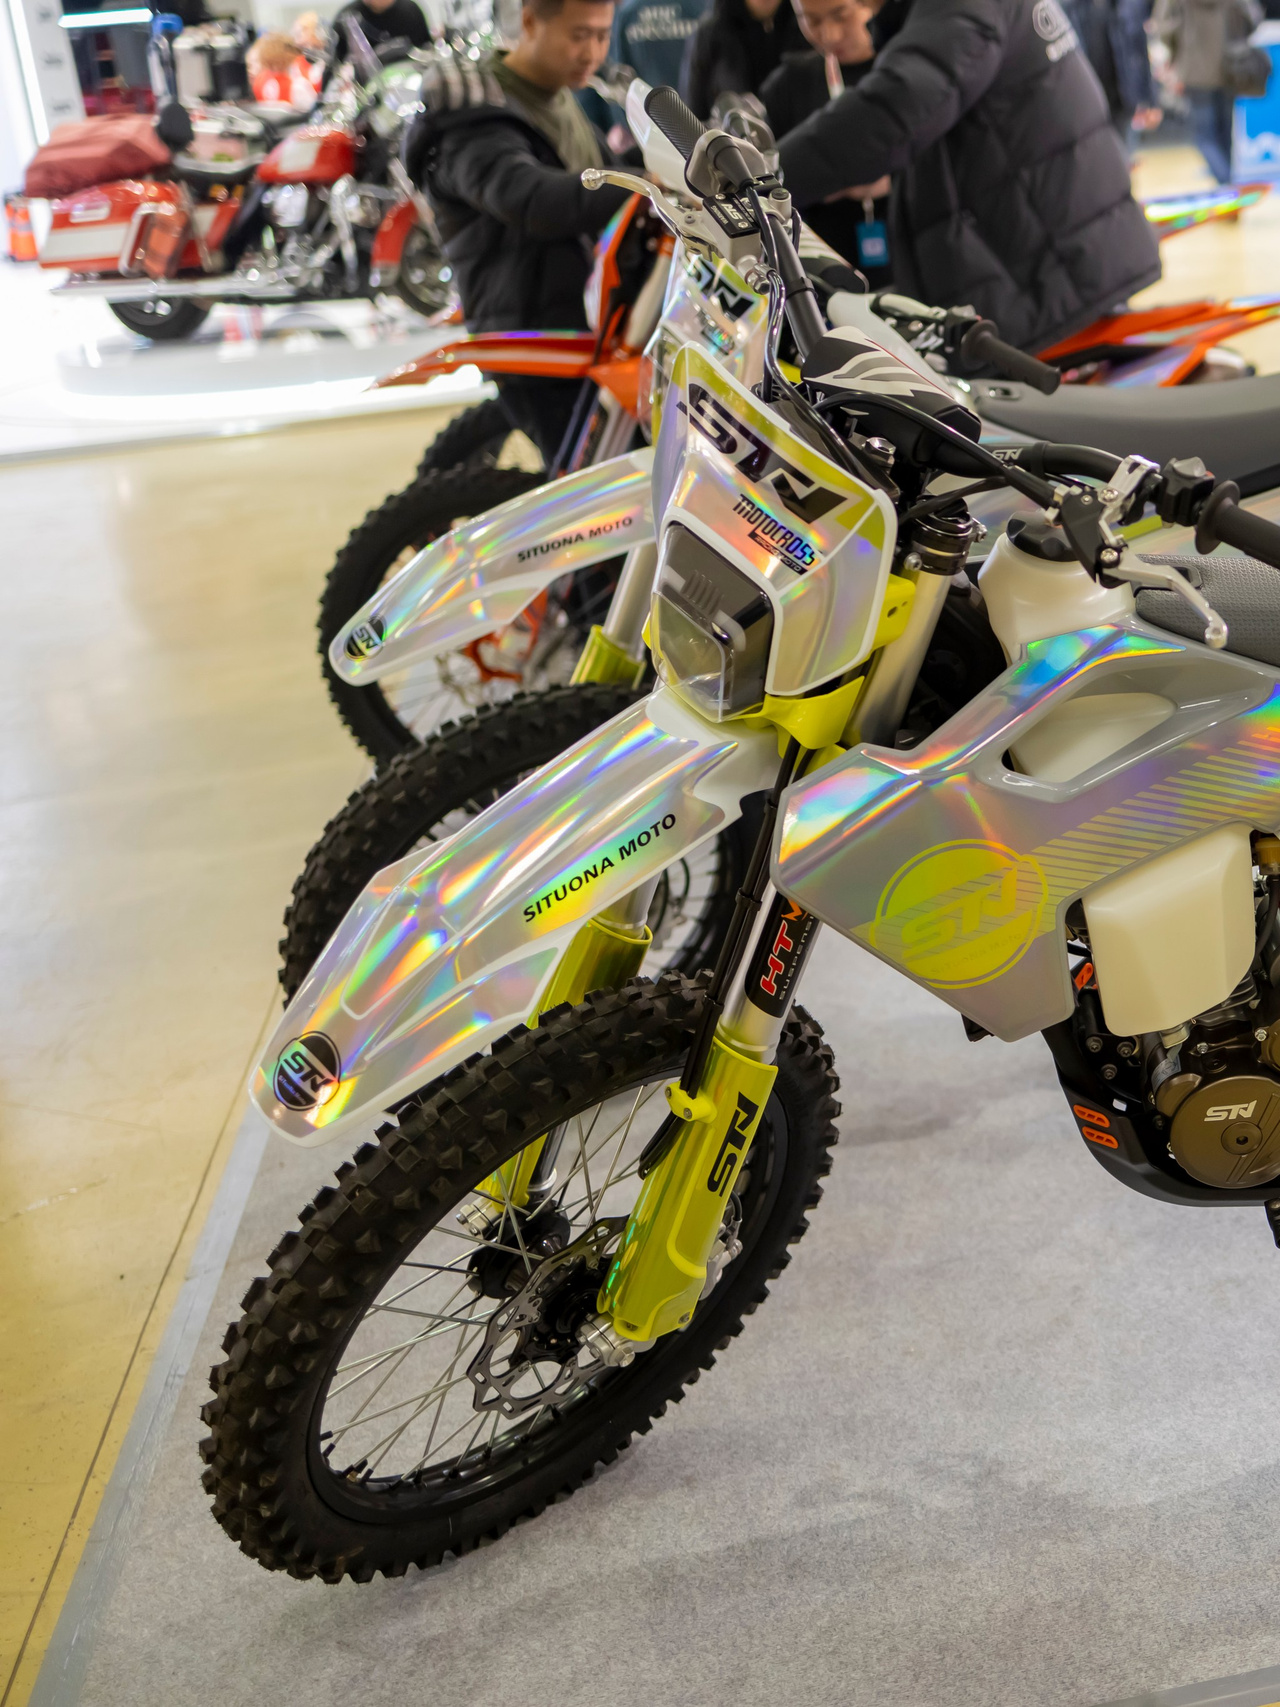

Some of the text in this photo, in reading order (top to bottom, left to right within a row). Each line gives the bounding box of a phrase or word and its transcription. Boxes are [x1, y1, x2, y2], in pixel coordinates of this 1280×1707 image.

[518, 516, 632, 562] SITUONA MOTO
[733, 494, 823, 567] MOTOCROSS
[523, 813, 676, 922] SITUONA MOTO
